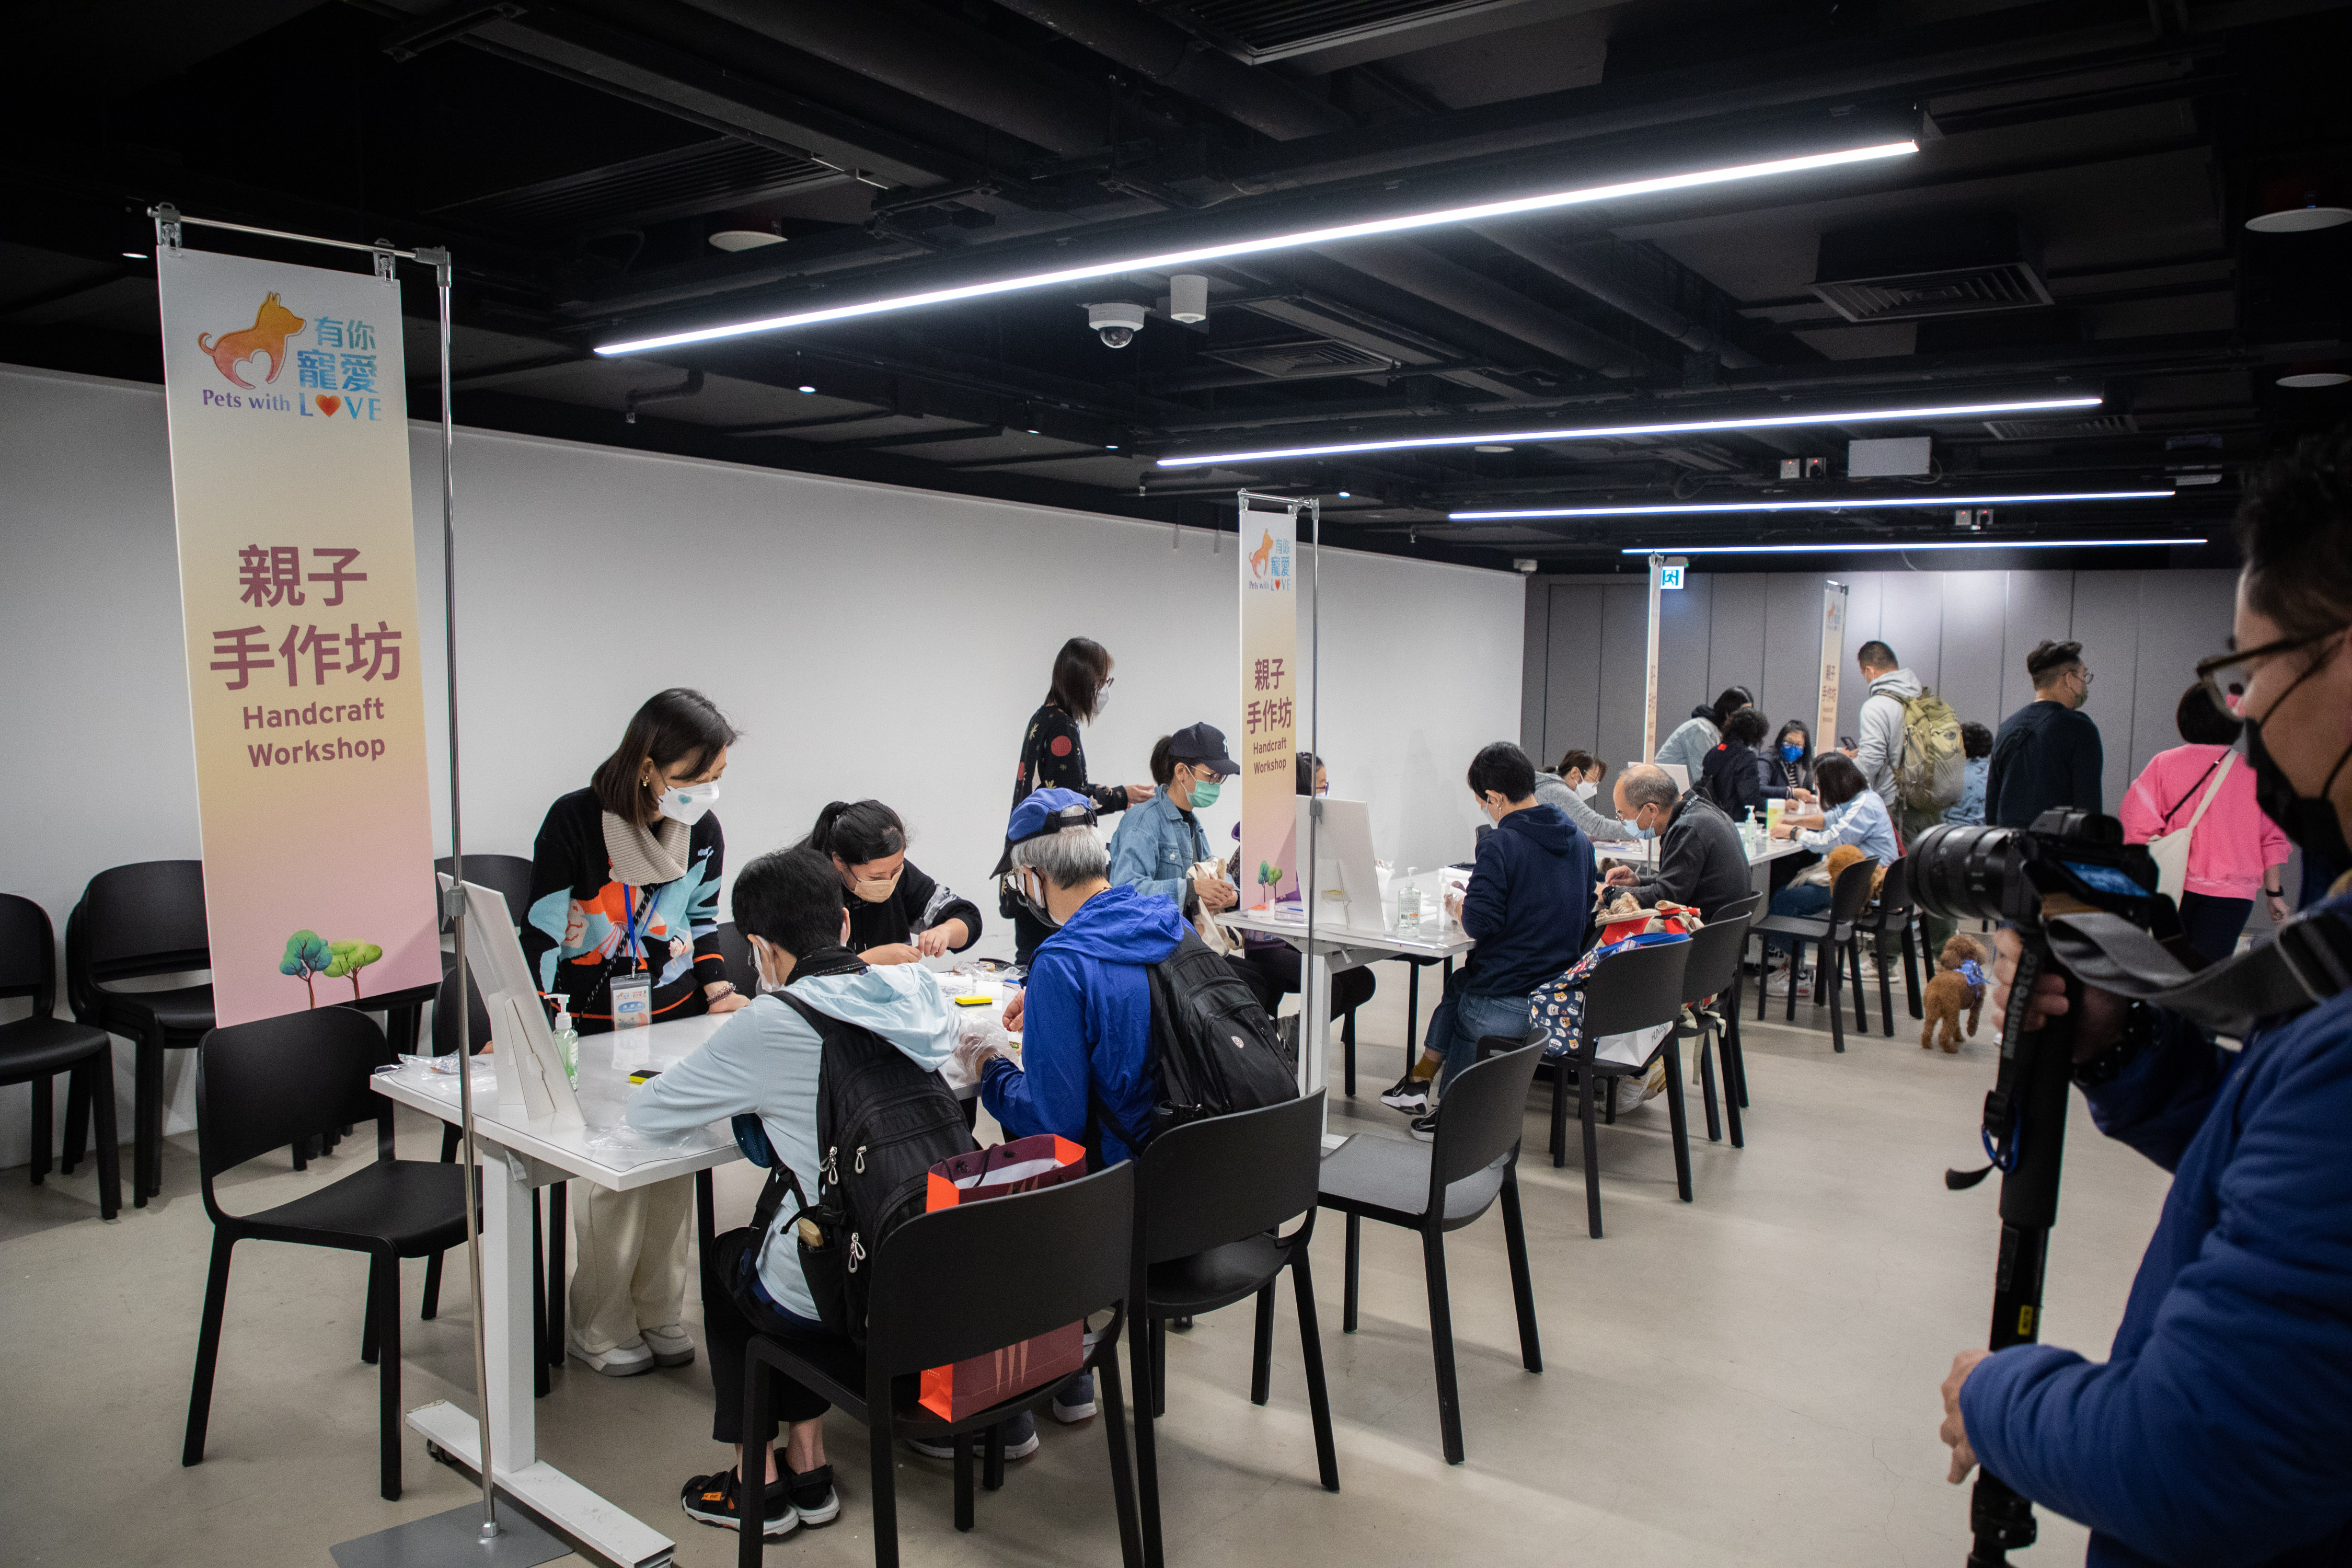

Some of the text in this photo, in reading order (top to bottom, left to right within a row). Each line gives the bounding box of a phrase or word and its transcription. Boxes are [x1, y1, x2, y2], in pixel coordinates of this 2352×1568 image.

[314, 316, 376, 350] 有你
[297, 349, 378, 394] 寵愛
[203, 389, 241, 408] Pets
[248, 394, 291, 412] with
[238, 544, 367, 607] 親子
[1249, 581, 1259, 590] Pets
[1260, 580, 1269, 590] with
[210, 620, 402, 690] 手作坊
[1255, 658, 1285, 691] 親子
[243, 697, 385, 730] Handcraft
[1247, 696, 1292, 734] 手作坊
[247, 736, 385, 767] Workshop
[1253, 737, 1287, 755] Handcraft
[1254, 758, 1286, 775] Workshop
